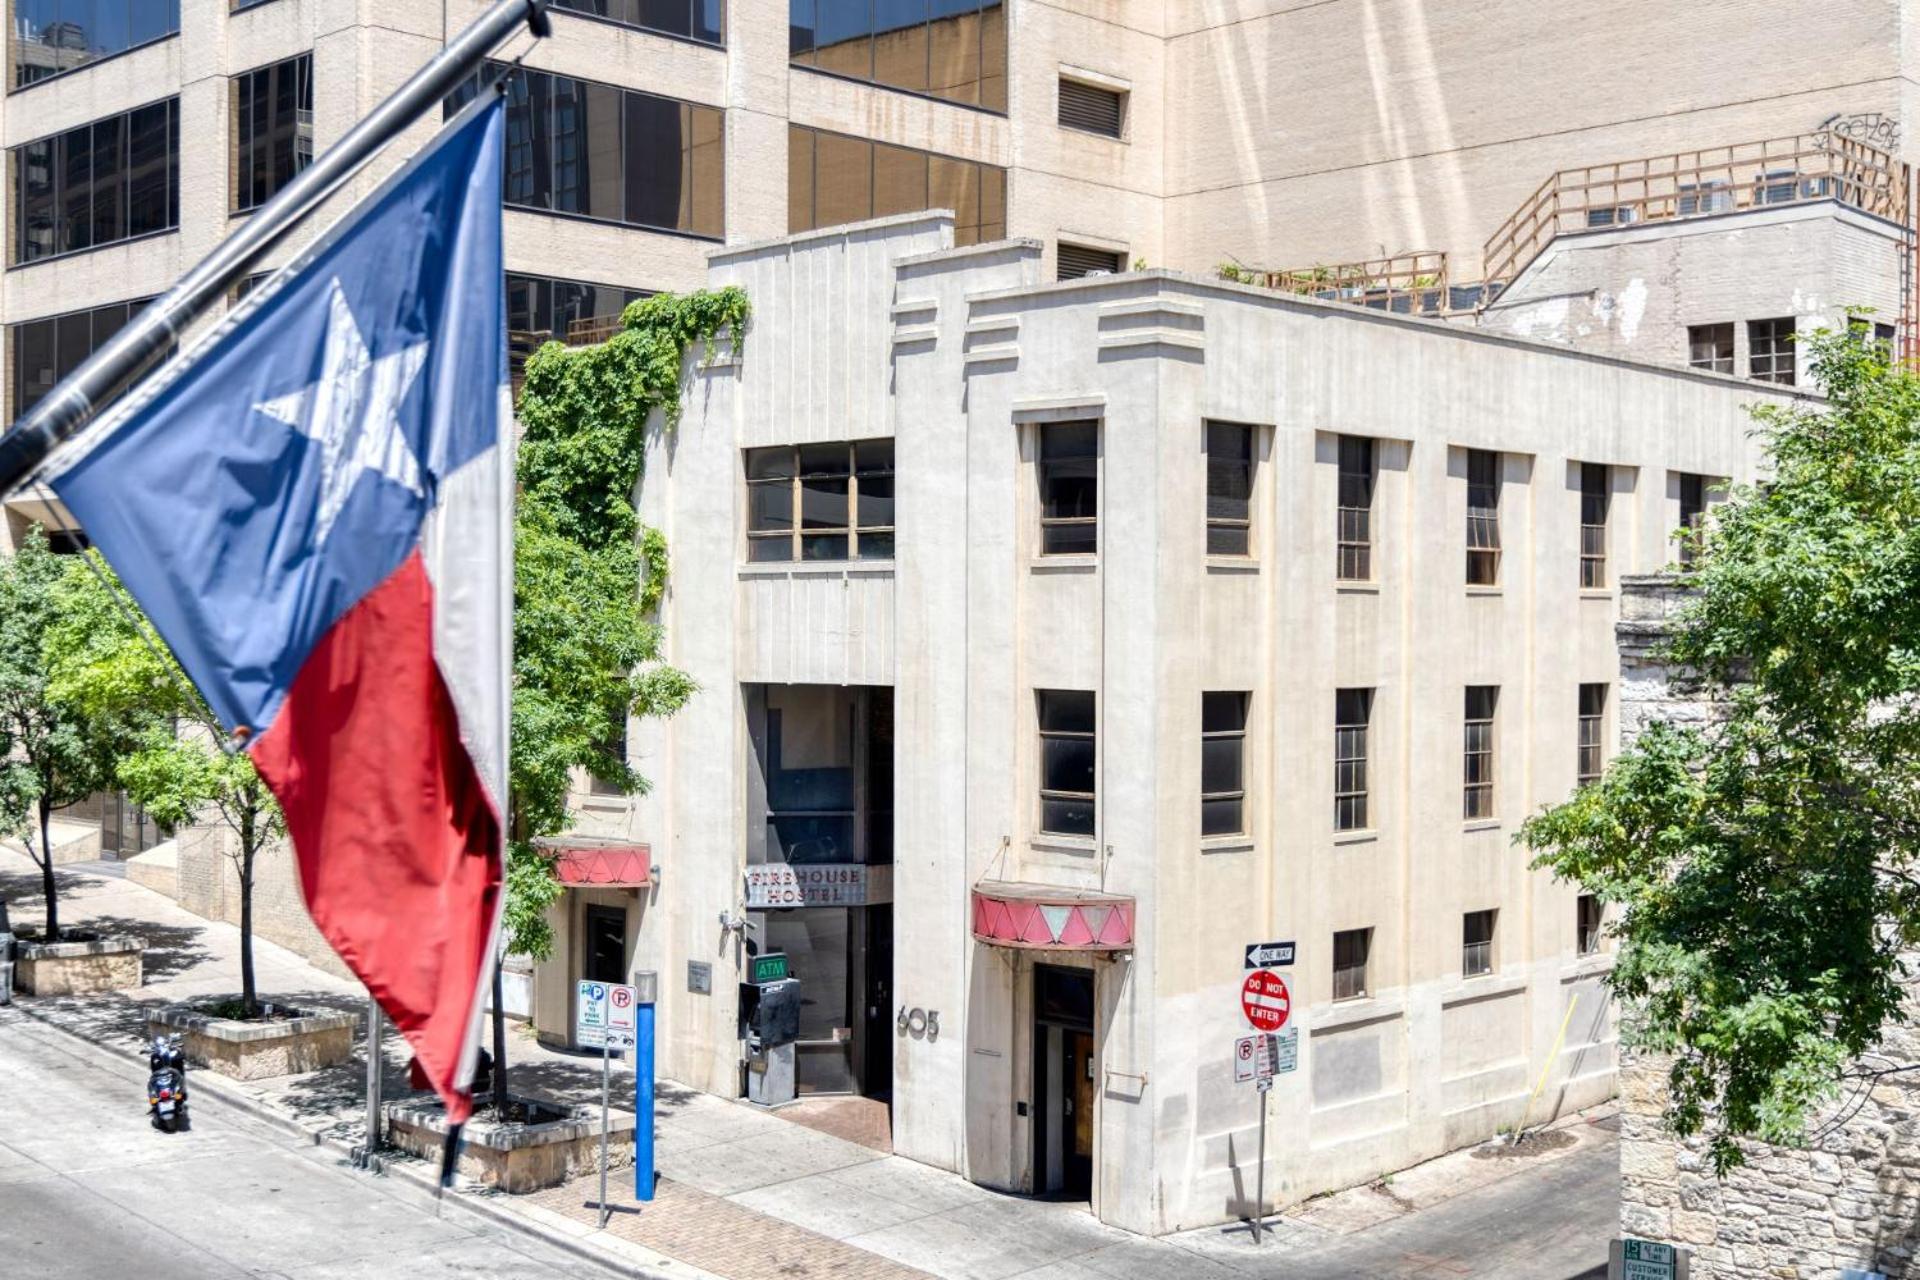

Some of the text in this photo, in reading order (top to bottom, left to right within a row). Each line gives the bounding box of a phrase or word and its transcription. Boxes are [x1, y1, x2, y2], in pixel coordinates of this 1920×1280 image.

[749, 870, 859, 886] FIREHOUSE
[767, 888, 842, 903] HOSTEL
[1260, 948, 1291, 961] ONE WAY
[758, 961, 785, 977] ATM
[1248, 979, 1284, 994] DO NOT
[896, 1005, 940, 1038] 605
[1250, 1006, 1280, 1023] ENTER
[1626, 1240, 1639, 1253] 15
[1654, 1245, 1668, 1254] ANY
[1627, 1262, 1668, 1275] CUSTOMER
